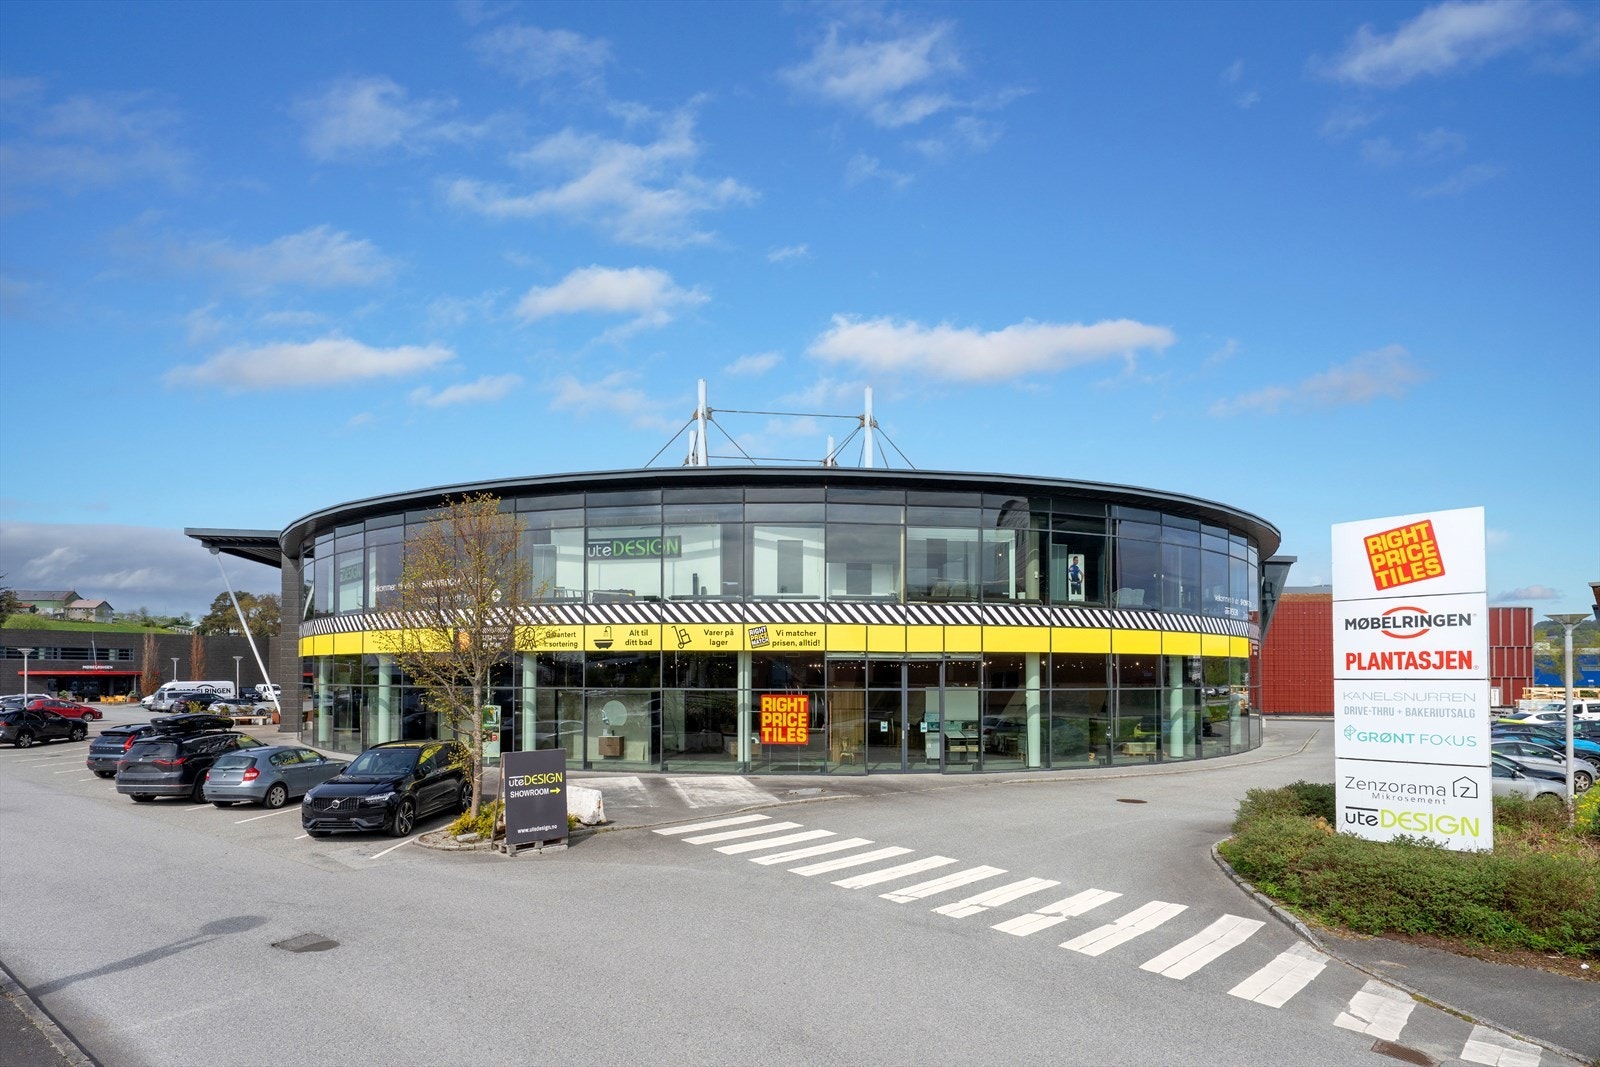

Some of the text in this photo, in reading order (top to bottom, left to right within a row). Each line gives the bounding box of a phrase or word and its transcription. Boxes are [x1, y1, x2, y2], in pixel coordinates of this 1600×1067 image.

[1366, 522, 1430, 555] RIGHT
[1371, 540, 1437, 571] PRICE
[1376, 557, 1442, 588] TILES
[1345, 613, 1472, 631] MØBELRINGEN
[629, 629, 639, 637] Alt
[725, 629, 734, 638] på
[786, 629, 817, 637] matcher
[549, 641, 578, 649] sortering
[709, 639, 728, 647] lager
[772, 639, 820, 648] prisen, alltid!
[1345, 650, 1473, 671] PLANTASJEN
[1343, 691, 1476, 702] KANELSNURREN
[762, 697, 807, 712] RIGHT
[1344, 706, 1395, 716] DRIVE-THRU
[1405, 707, 1475, 719] BAKERIUTSALG
[762, 712, 807, 727] PRICE
[762, 727, 807, 742] TILES
[1357, 731, 1415, 744] GRØNT
[509, 772, 563, 787] uteDESIGN
[1345, 775, 1446, 797] Zenzorama
[510, 788, 549, 798] SHOWROOM
[1372, 792, 1446, 805] Mikrosement
[1345, 807, 1479, 837] uteDESIGN
[517, 825, 558, 833] www.utedesign.no
